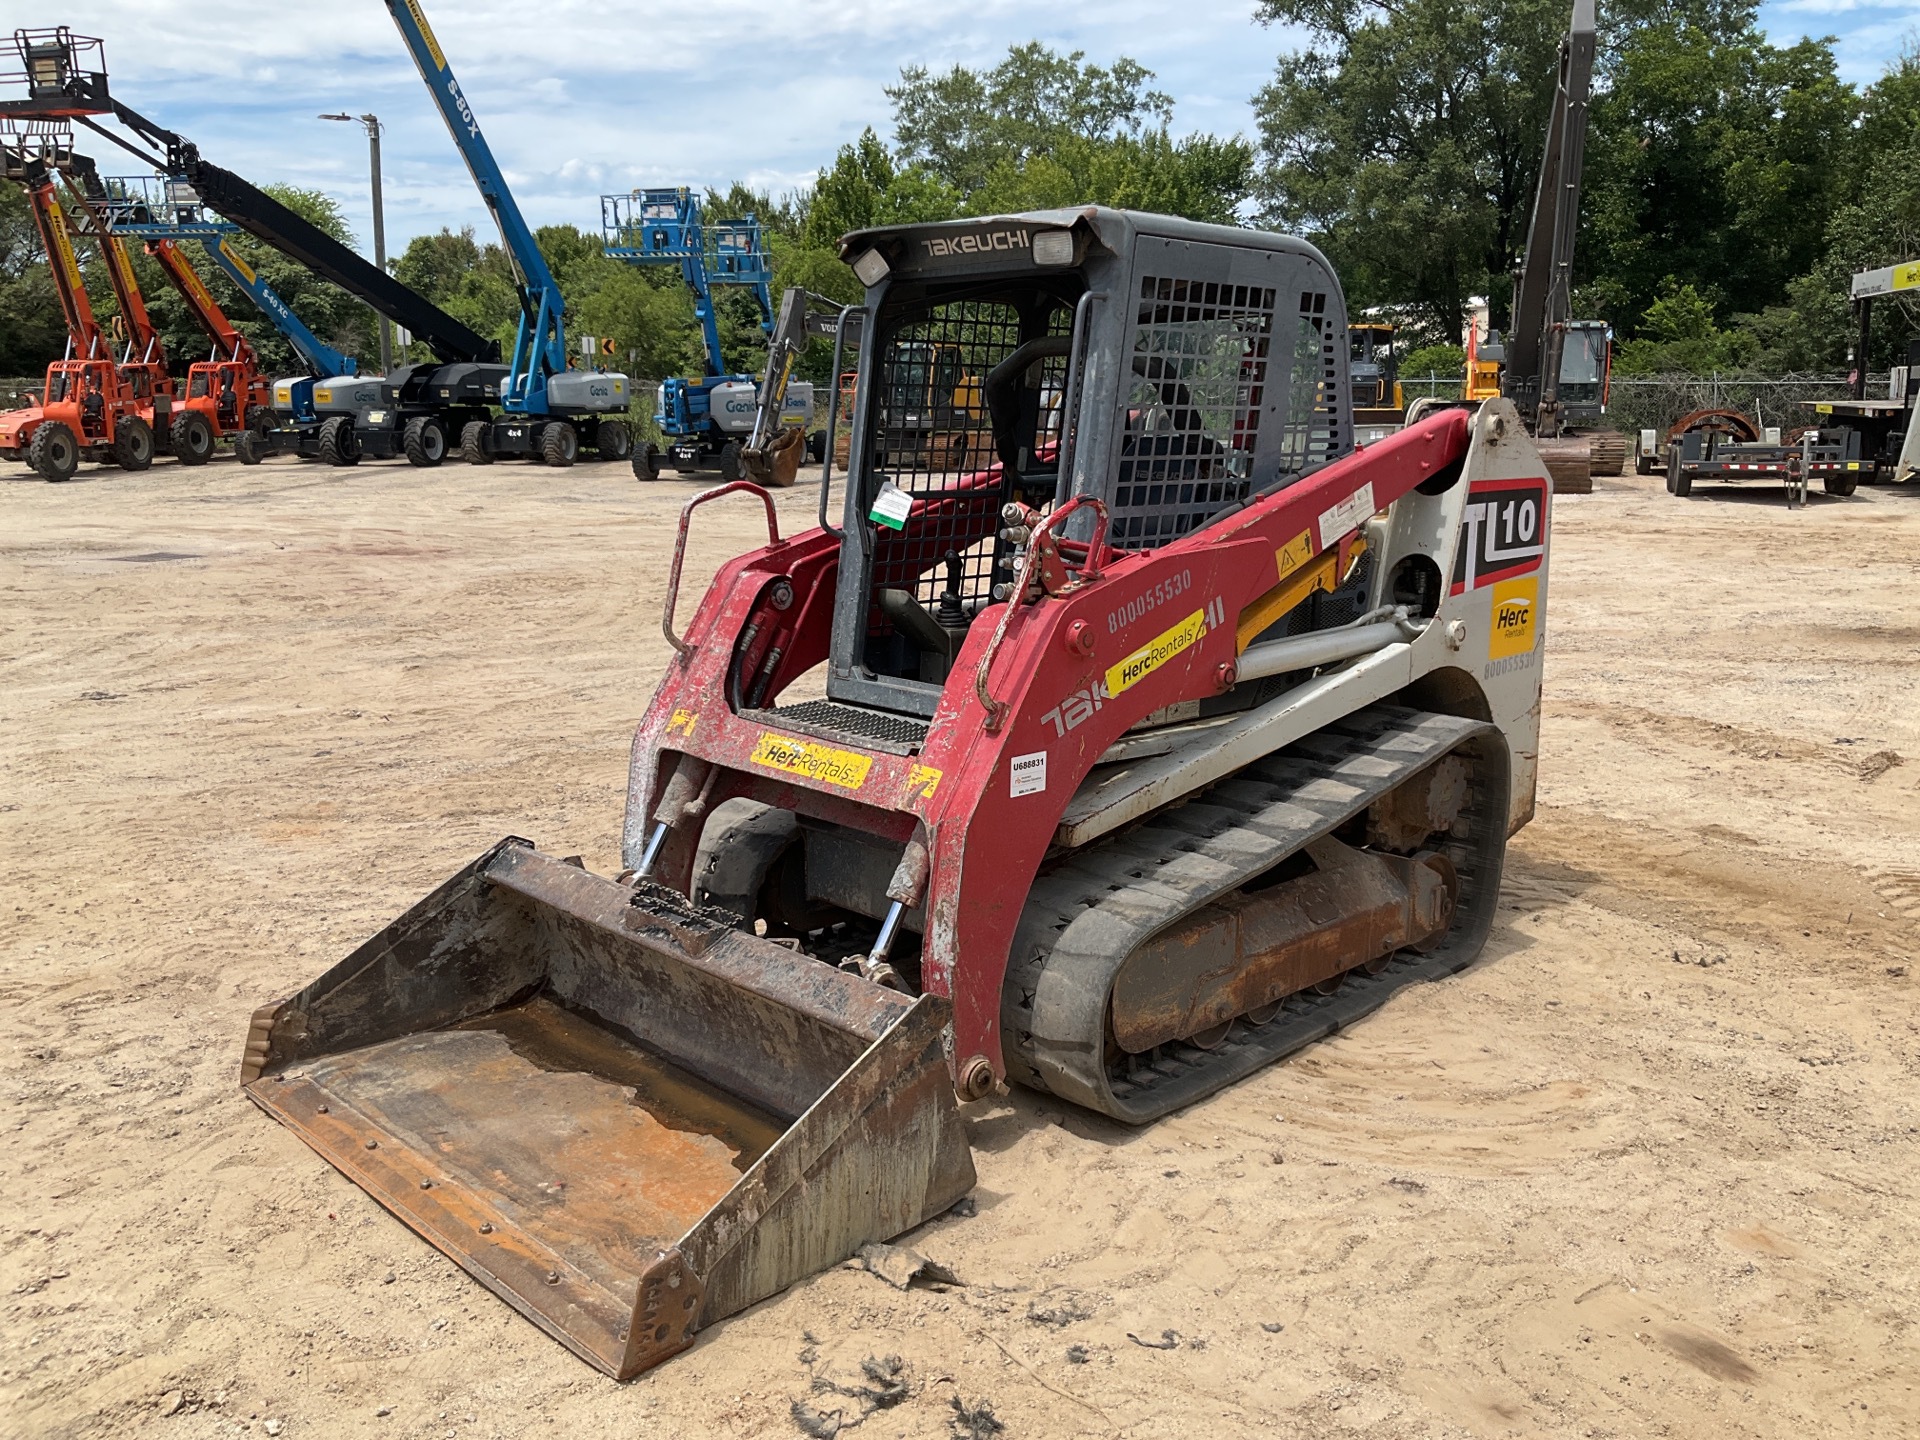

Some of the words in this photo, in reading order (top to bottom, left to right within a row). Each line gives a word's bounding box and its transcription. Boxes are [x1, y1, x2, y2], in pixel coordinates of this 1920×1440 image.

[113, 236, 132, 284] ercRentals
[590, 385, 608, 397] Genie
[786, 398, 806, 408] Genie
[507, 429, 522, 437] 4x4
[1107, 568, 1191, 634] 800055530
[1496, 607, 1529, 630] Herc
[1504, 627, 1525, 639] Rentals
[1122, 627, 1193, 685] HercRentals
[764, 744, 853, 781] HercRentals
[1013, 758, 1045, 771] U688831
